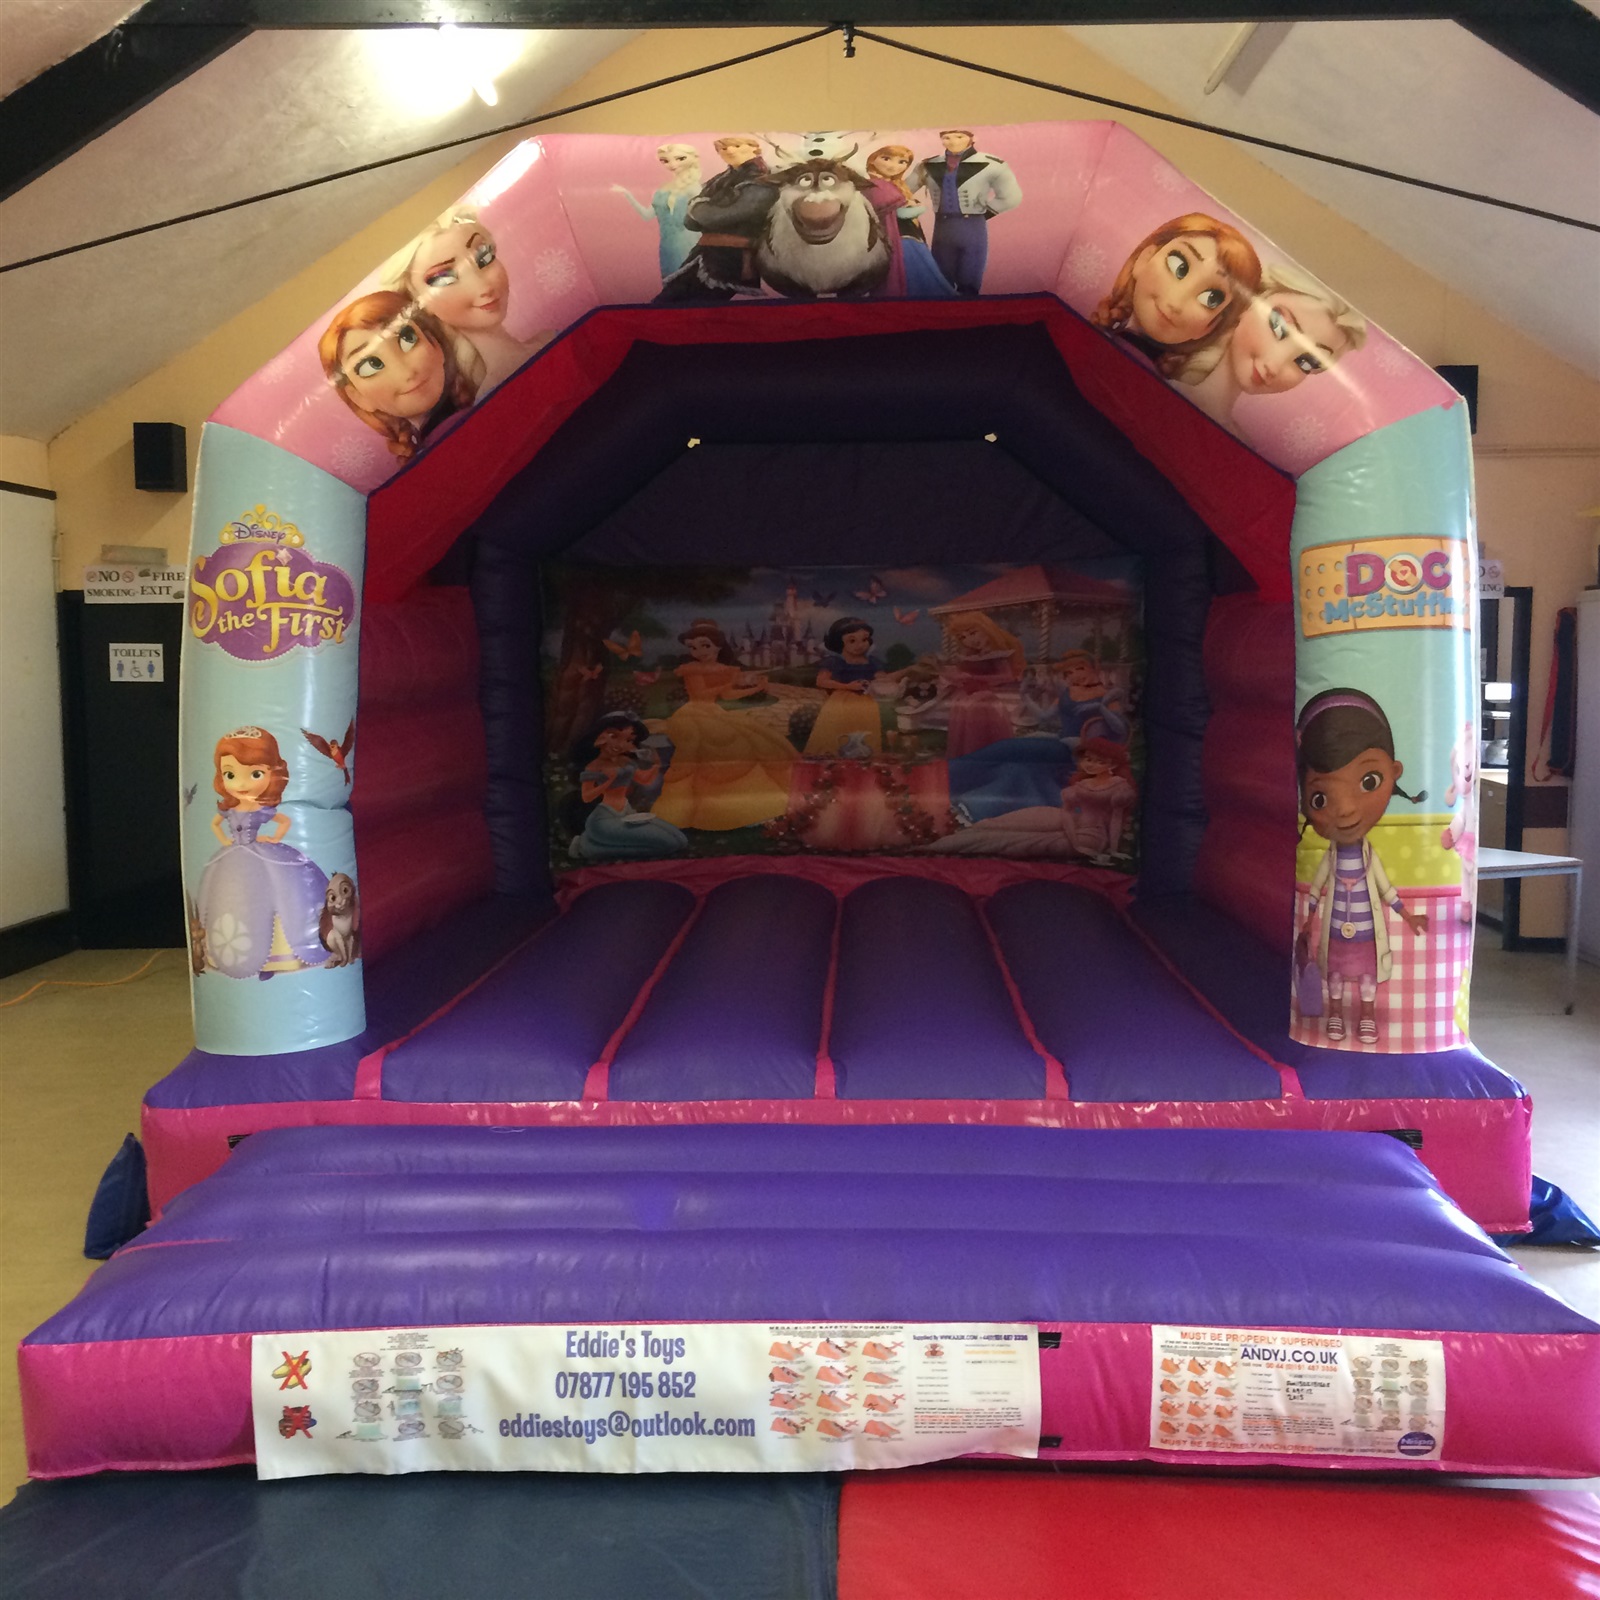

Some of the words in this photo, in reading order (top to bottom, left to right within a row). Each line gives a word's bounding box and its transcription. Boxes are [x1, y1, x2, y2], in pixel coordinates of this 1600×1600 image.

[231, 522, 286, 543] Disney
[98, 570, 120, 582] NO
[152, 571, 185, 582] FIRE
[1345, 551, 1452, 597] DOC
[86, 588, 136, 597] SMOKING
[140, 585, 173, 596] EXIT
[190, 549, 328, 639] Sofia
[217, 610, 255, 634] the
[256, 602, 346, 653] First
[112, 648, 161, 658] TOILETS
[566, 1330, 636, 1358] Eddie's
[641, 1330, 685, 1365] Toys
[1180, 1331, 1207, 1341] MUST
[1210, 1332, 1223, 1342] BE
[1225, 1333, 1278, 1346] PROPERLY
[1280, 1336, 1343, 1348] SUPERVISED
[1240, 1347, 1338, 1365] ANDYJ.CO.UK
[555, 1371, 615, 1399] 07877
[619, 1371, 653, 1399] 195
[658, 1371, 696, 1398] 852
[499, 1410, 756, 1444] eddiestoys@outlook.com
